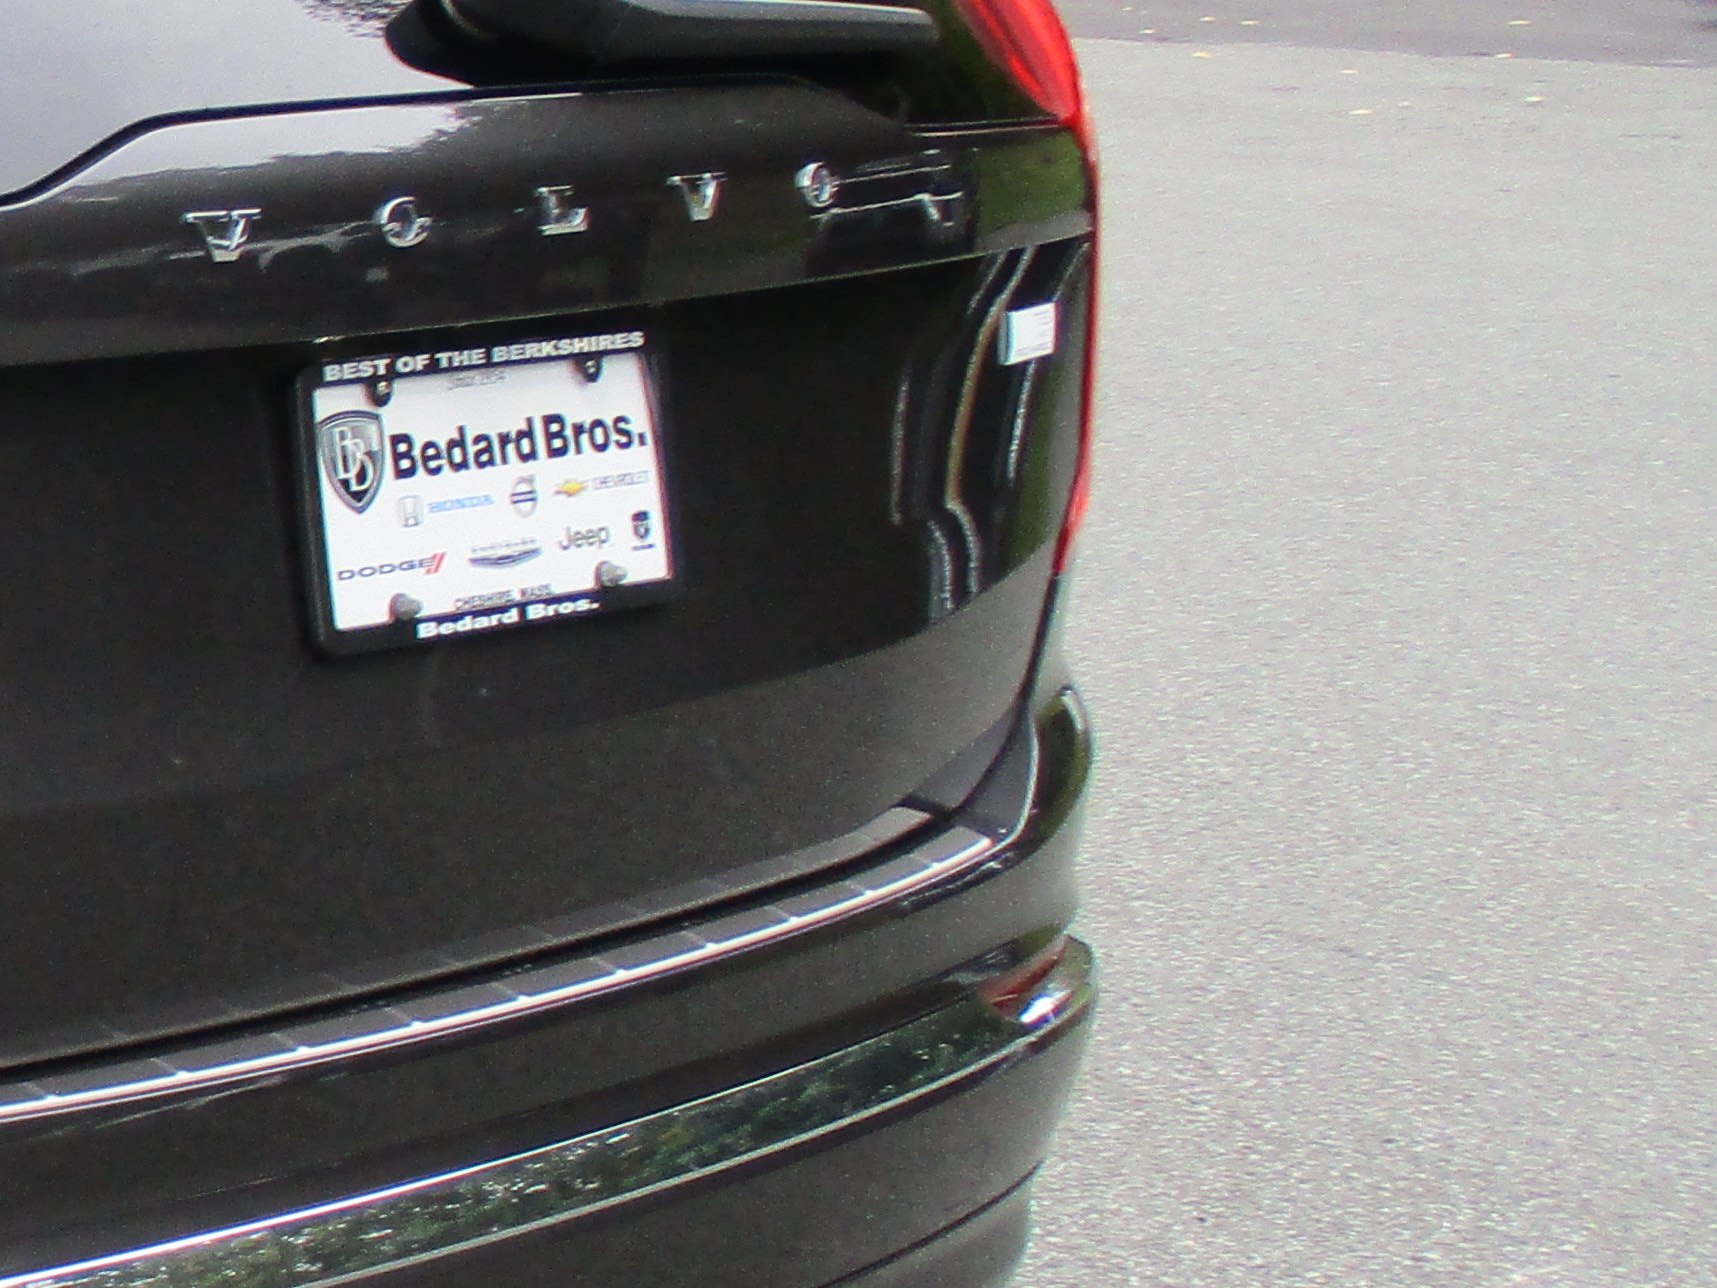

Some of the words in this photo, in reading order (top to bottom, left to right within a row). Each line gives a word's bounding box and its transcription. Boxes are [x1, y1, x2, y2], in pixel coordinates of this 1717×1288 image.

[183, 160, 841, 263] VOLVO
[322, 357, 392, 382] BEST
[394, 354, 432, 374] OF
[434, 347, 488, 369] THE
[491, 330, 646, 363] BERKSHIRES
[426, 493, 496, 514] HONDA
[558, 524, 611, 552] Jeep
[337, 556, 436, 581] DODGE
[416, 606, 521, 640] Bedard
[524, 597, 602, 621] Bros.
